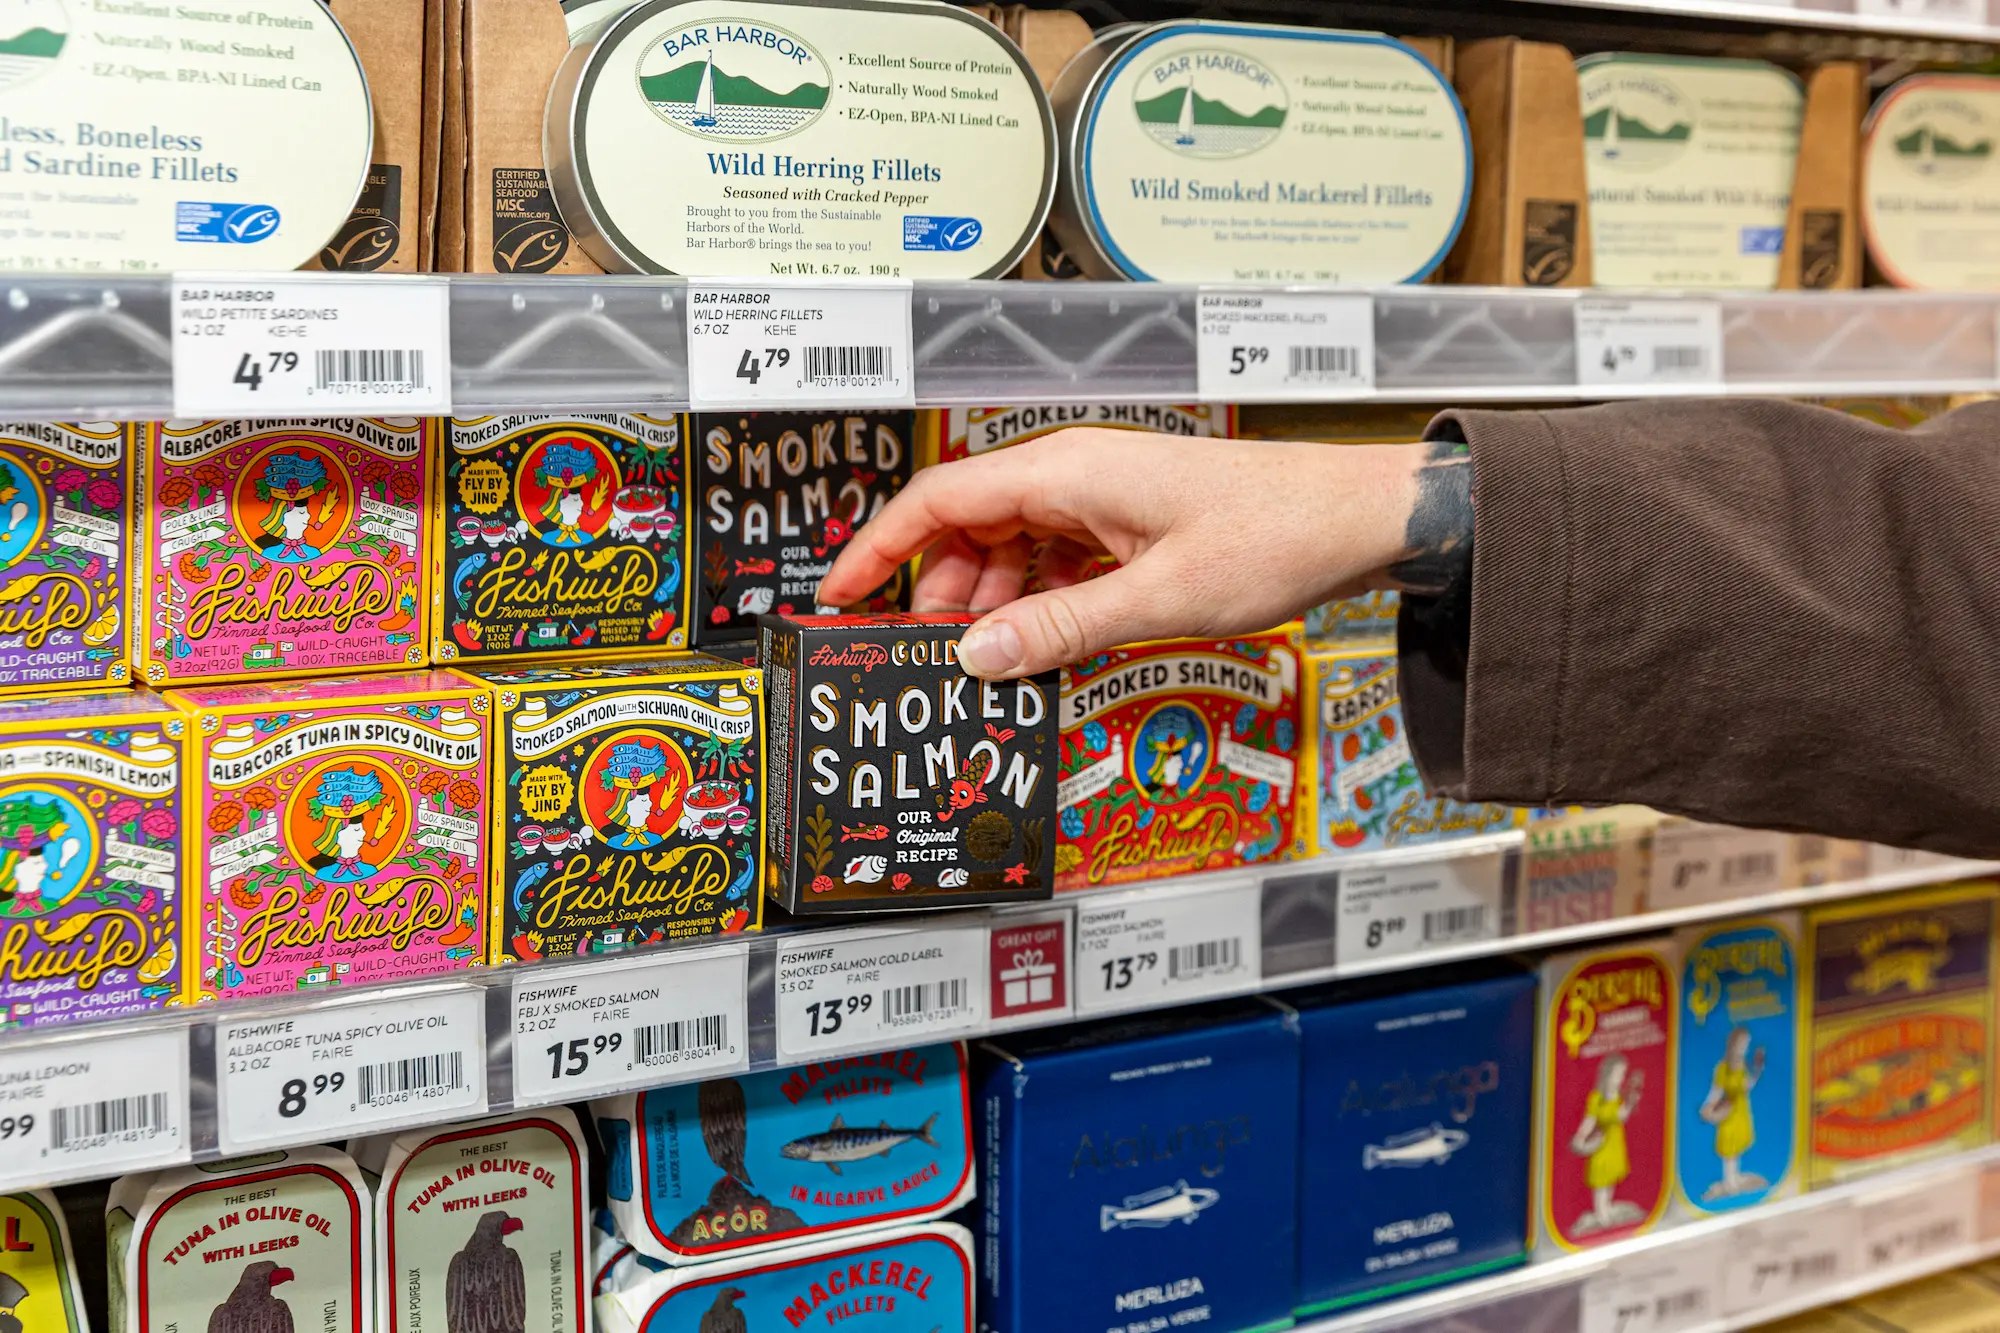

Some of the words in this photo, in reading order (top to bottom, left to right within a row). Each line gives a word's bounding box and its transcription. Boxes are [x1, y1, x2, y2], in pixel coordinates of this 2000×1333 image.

[663, 27, 710, 59] BAR
[848, 53, 905, 68] Excellent
[909, 57, 951, 71] Source
[955, 60, 969, 72] of
[971, 60, 1012, 75] Protein
[848, 81, 908, 99] Naturally
[913, 84, 946, 98] Wood
[951, 87, 998, 100] Smoked
[849, 108, 907, 124] EZ-Open,
[911, 111, 955, 124] BPA-NI
[960, 113, 993, 126] Lined
[996, 115, 1019, 127] Can
[77, 122, 202, 151] Boneless
[23, 151, 141, 178] Sardine
[152, 157, 238, 183] Fillets
[495, 170, 540, 180] CERTIFIED
[707, 153, 765, 176] Wild
[774, 155, 864, 186] Herring
[872, 158, 941, 182] Fillets
[495, 189, 538, 198] SEAFOOD
[723, 186, 789, 200] Seasoned
[793, 189, 821, 201] with
[825, 189, 879, 202] Cracked
[884, 191, 928, 207] Pepper
[1130, 177, 1180, 200] Wild
[1187, 180, 1270, 204] Smoked
[1276, 182, 1369, 206] Mackerel
[495, 211, 550, 220] www.msc.org
[496, 199, 525, 212] MSC
[687, 206, 731, 219] Brought
[735, 207, 745, 216] to
[749, 209, 769, 221] you
[772, 208, 798, 219] from
[801, 208, 817, 219] the
[821, 209, 882, 221] Sustainable
[687, 222, 730, 233] Harbors
[733, 222, 744, 233] of
[748, 222, 765, 233] the
[768, 223, 804, 234] World.
[686, 238, 705, 248] Bar
[759, 239, 793, 253] brings
[796, 239, 812, 250] the
[815, 243, 832, 251] sea
[835, 241, 845, 251] to
[849, 241, 872, 253] you!
[770, 262, 793, 274] Net
[796, 263, 818, 274] Wt.
[822, 263, 840, 274] 6.7
[843, 266, 860, 274] oz.
[869, 264, 890, 275] 190
[893, 266, 900, 277] g
[181, 291, 209, 301] BAR
[214, 291, 275, 302] HARBOR
[694, 294, 718, 304] BAR
[720, 294, 771, 304] HARBOR
[694, 309, 723, 320] WILD
[726, 310, 777, 320] HERRING
[780, 310, 823, 320] FILLETS
[694, 324, 710, 335] 6.7
[712, 325, 729, 335] OZ
[764, 325, 797, 336] KEHE
[232, 352, 263, 391] 4
[268, 352, 298, 372] 79
[736, 349, 761, 384] 4
[765, 348, 790, 368] 79
[1230, 347, 1246, 374] 5
[1249, 347, 1269, 363] 99
[164, 419, 242, 456] ALBACORE
[620, 418, 645, 437] CHILI
[648, 429, 676, 443] CRISP
[297, 635, 385, 652] WILD-CAUGHT
[808, 641, 888, 672] Fishwife
[891, 639, 960, 667] GOLD
[297, 654, 326, 666] 100%
[331, 648, 399, 664] TRACEABLE
[1073, 664, 1168, 718] SMOKED
[1179, 662, 1268, 699] SALMON
[809, 674, 1048, 748] SMOKED
[515, 727, 564, 750] SMOKED
[565, 707, 617, 733] SALMON
[617, 702, 636, 713] WITH
[638, 701, 688, 719] SICHUAN
[691, 709, 718, 730] CHILI
[720, 721, 750, 734] CRISP
[213, 739, 293, 781] ALBACORE
[299, 725, 340, 750] TUNA
[344, 724, 360, 741] IN
[364, 724, 410, 744] SPICY
[413, 731, 453, 760] OLIVE
[455, 744, 478, 760] OIL
[45, 750, 115, 778] SPANISH
[120, 762, 172, 786] LEMON
[808, 734, 1042, 809] SALMON
[526, 785, 549, 798] FLY
[551, 784, 565, 796] BY
[531, 799, 561, 813] JING
[897, 811, 932, 825] OUR
[896, 826, 959, 847] Original
[895, 848, 958, 863] RECIPE
[237, 874, 454, 968] Fishwife
[1366, 919, 1383, 948] 8
[998, 931, 1032, 948] GREAT
[1034, 928, 1058, 942] GIFT
[780, 949, 834, 965] FISHWIFE
[780, 963, 828, 980] SMOKED
[829, 958, 877, 972] SALMON
[879, 953, 910, 967] GOLD
[911, 948, 943, 961] LABEL
[1101, 957, 1133, 991] 13
[1137, 952, 1158, 971] 79
[518, 1005, 541, 1019] FBJ
[543, 1004, 551, 1015] X
[554, 996, 606, 1013] SMOKED
[607, 988, 659, 1006] SALMON
[519, 985, 578, 1003] FISHWIFE
[806, 998, 844, 1037] 13
[847, 993, 873, 1016] 99
[227, 1036, 301, 1058] ALBACORE
[307, 1032, 342, 1046] TUNA
[345, 1025, 383, 1041] SPICY
[386, 1017, 424, 1034] OLIVE
[427, 1015, 448, 1028] OIL
[228, 1021, 294, 1041] FISHWIFE
[228, 1061, 248, 1074] 3.2
[251, 1057, 271, 1070] OZ
[312, 1045, 354, 1061] FAIRE
[546, 1037, 589, 1080] 15
[593, 1032, 622, 1056] 99
[36, 1062, 90, 1081] LEMON
[278, 1078, 307, 1119] 8
[313, 1072, 345, 1096] 99
[460, 1147, 480, 1157] THE
[483, 1142, 508, 1153] BEST
[407, 1176, 454, 1215] TUNA
[456, 1164, 475, 1182] IN
[480, 1159, 531, 1176] OLIVE
[533, 1167, 556, 1190] OIL
[791, 1185, 809, 1204] IN
[813, 1187, 886, 1206] ALGARVE
[892, 1162, 941, 1196] SAUCE
[443, 1196, 479, 1213] WITH
[484, 1187, 528, 1205] LEEKS
[783, 1260, 934, 1329] MACKEREL
[825, 1294, 896, 1326] FILLETS
